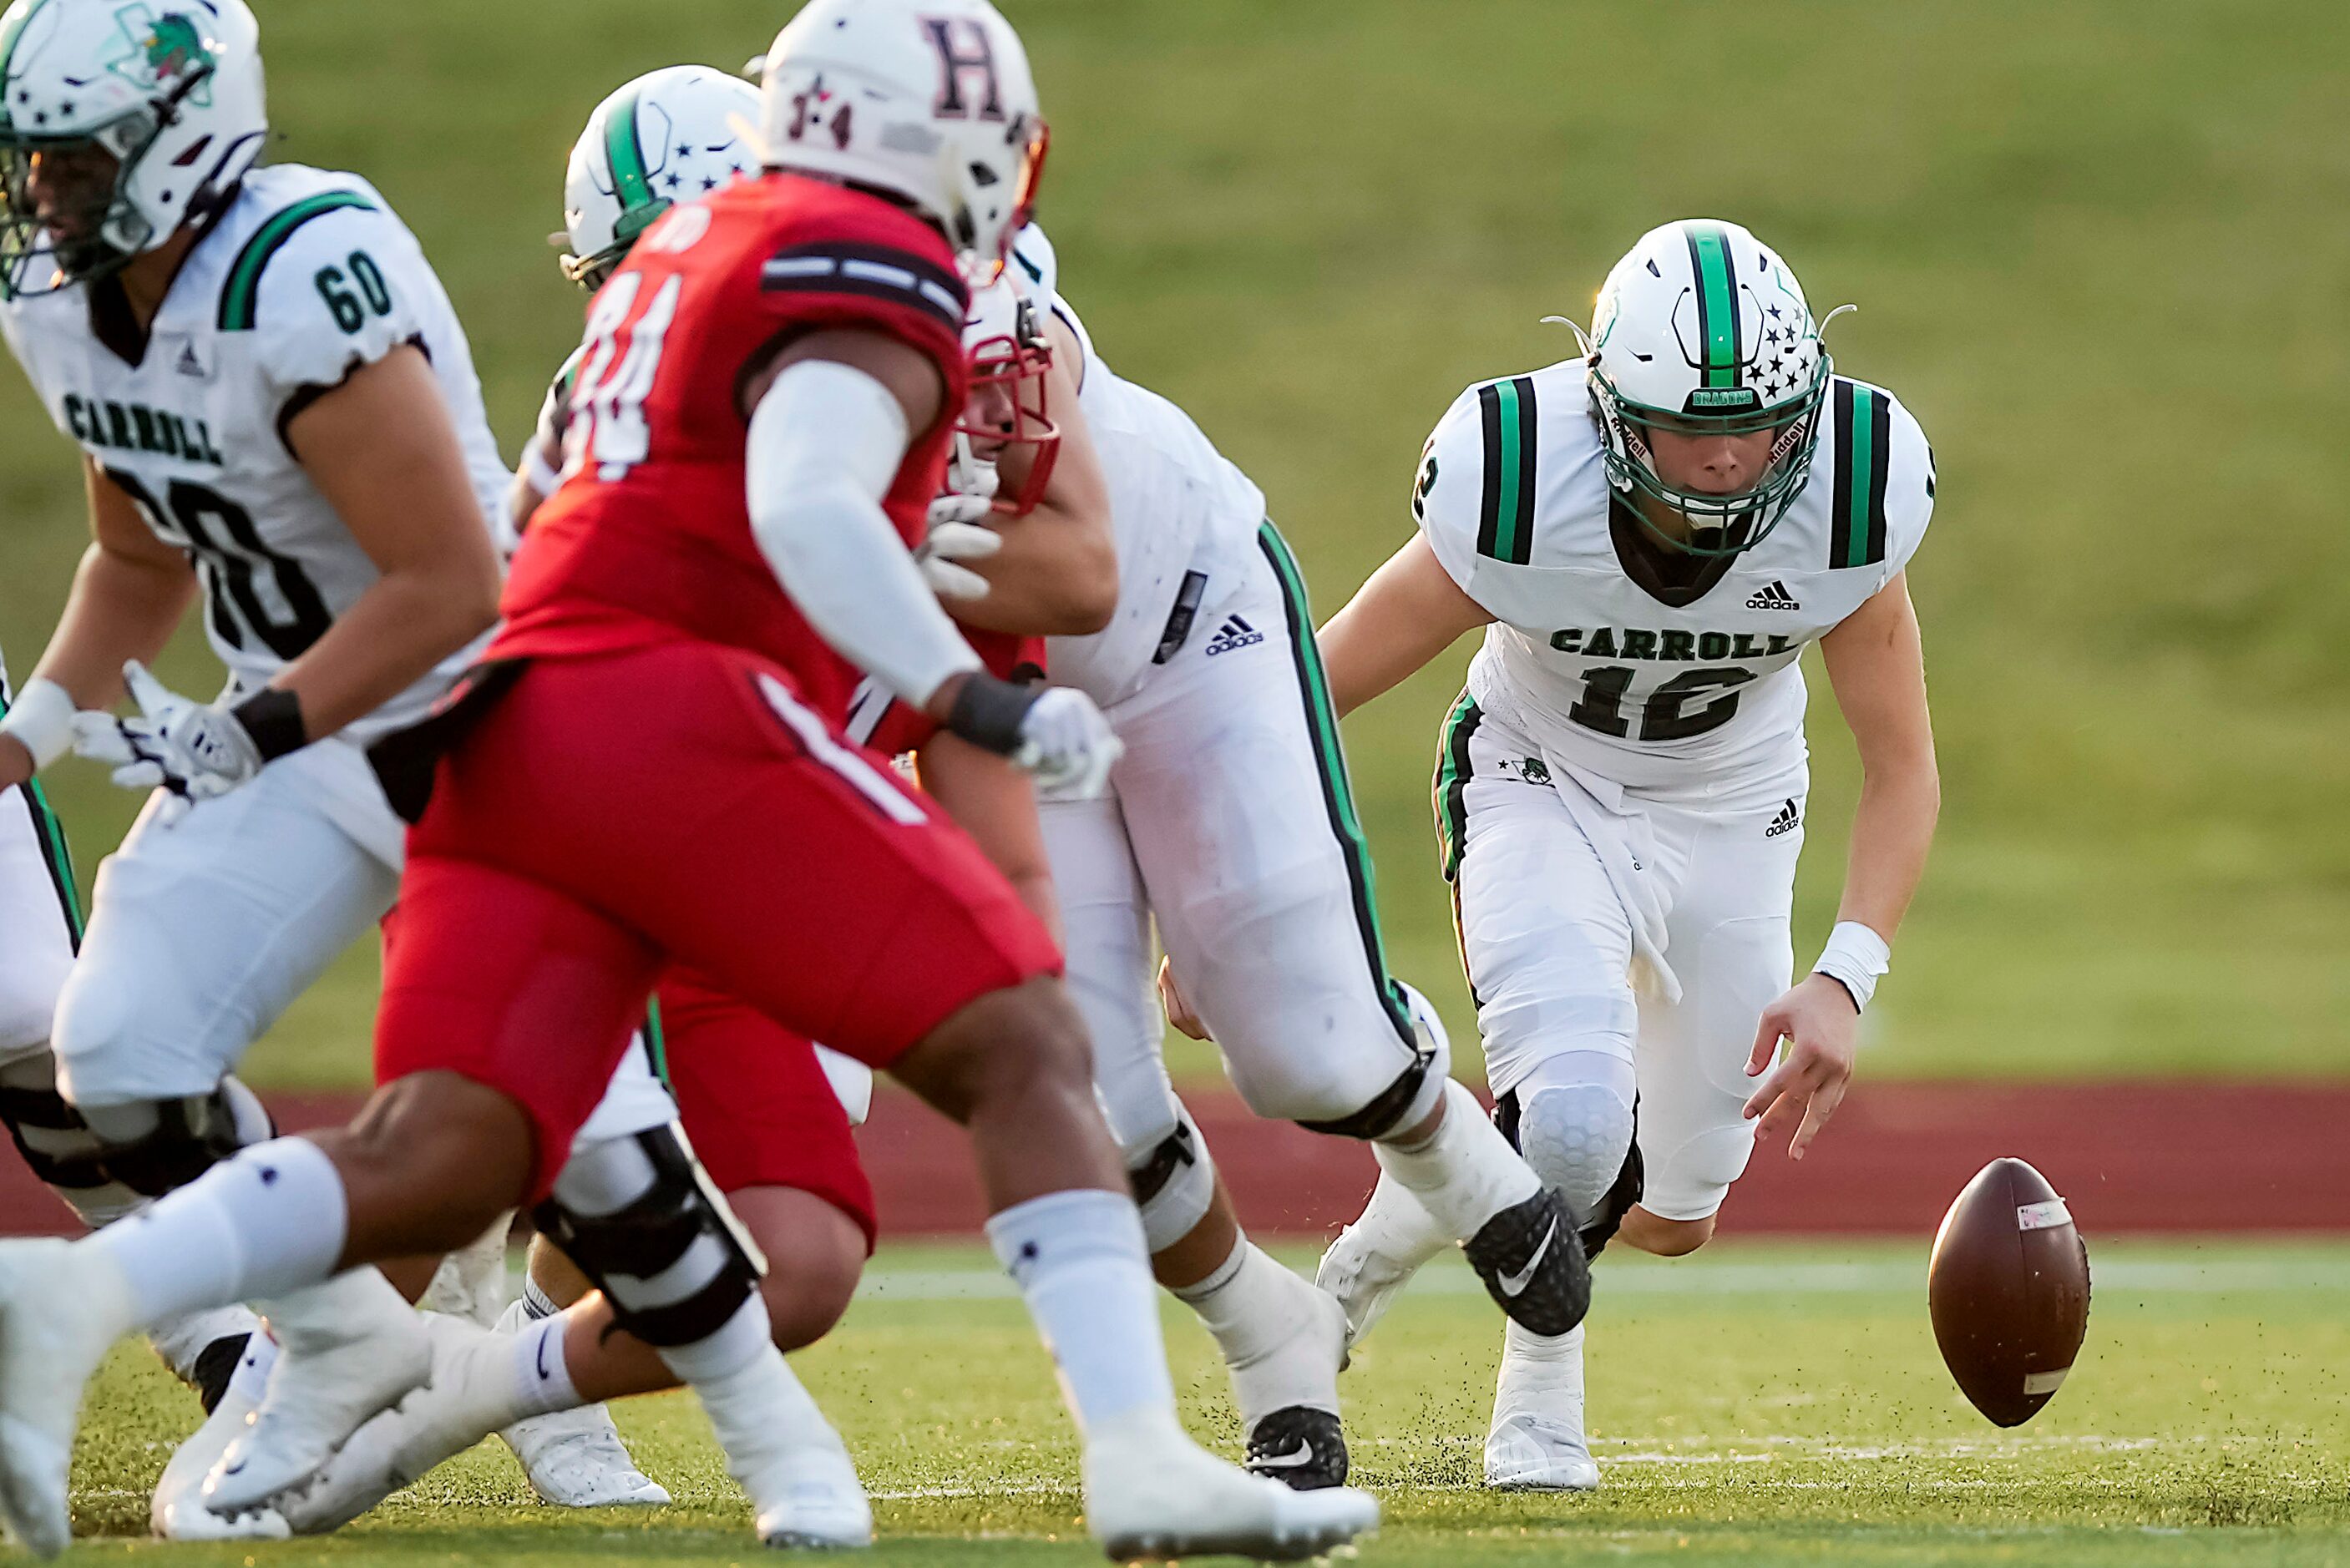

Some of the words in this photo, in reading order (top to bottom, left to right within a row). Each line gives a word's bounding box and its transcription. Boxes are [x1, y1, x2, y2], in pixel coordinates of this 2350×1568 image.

[916, 12, 1005, 122] H
[314, 250, 392, 335] 60
[1692, 390, 1754, 407] DRAGONS
[63, 392, 224, 466] CARROLL
[1768, 421, 1806, 464] Riddell
[1745, 598, 1800, 611] adidas
[1205, 632, 1264, 656] adidas
[1549, 626, 1800, 661] CARROLL
[1765, 817, 1800, 838] adidas
